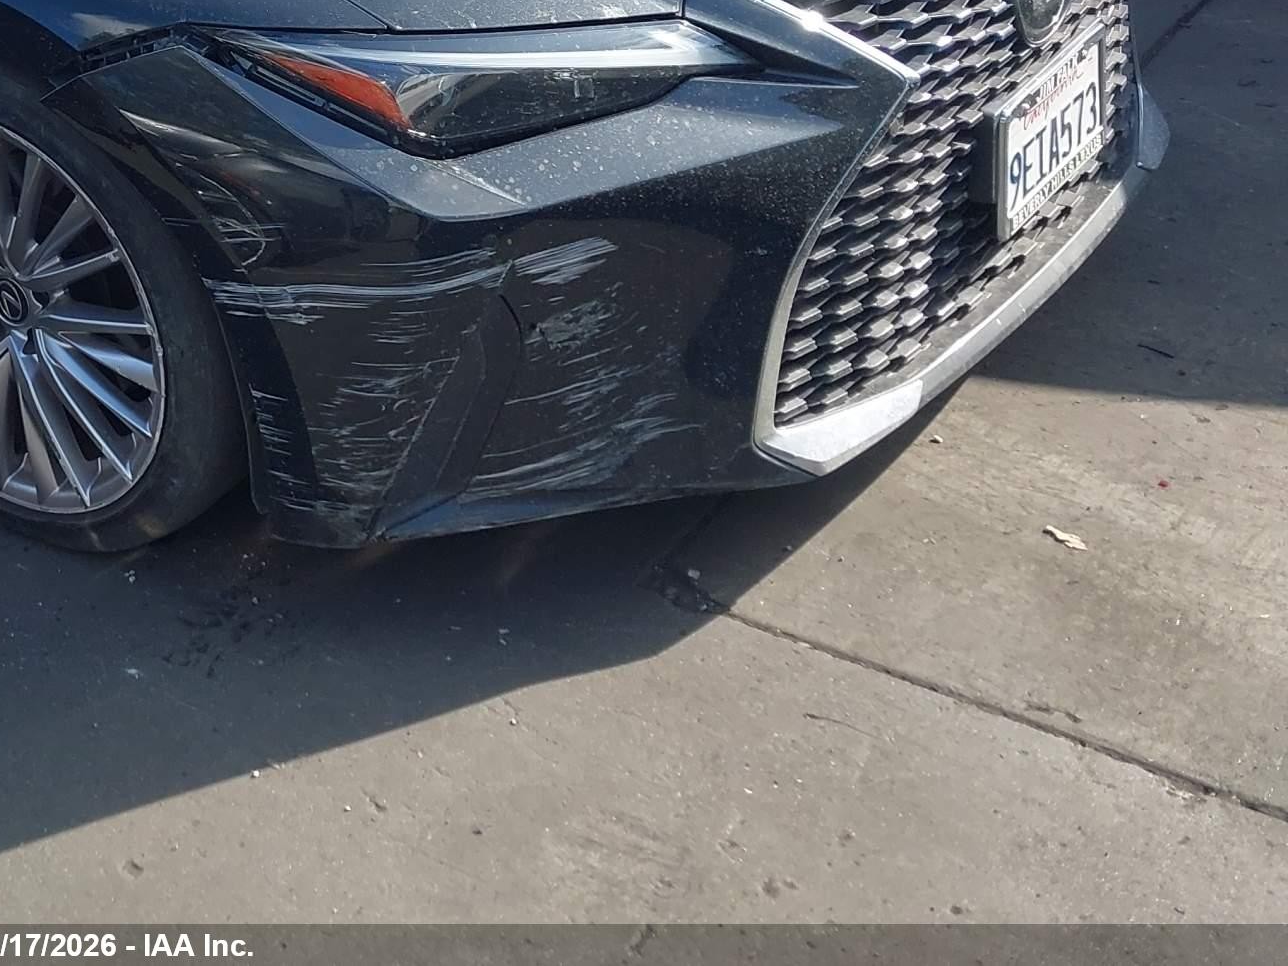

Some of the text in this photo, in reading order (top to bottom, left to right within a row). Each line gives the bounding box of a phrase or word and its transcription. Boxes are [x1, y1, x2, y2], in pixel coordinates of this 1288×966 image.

[1009, 81, 1097, 211] 9EIA573
[1012, 132, 1102, 231] BEVERLY HILLS LEXUS
